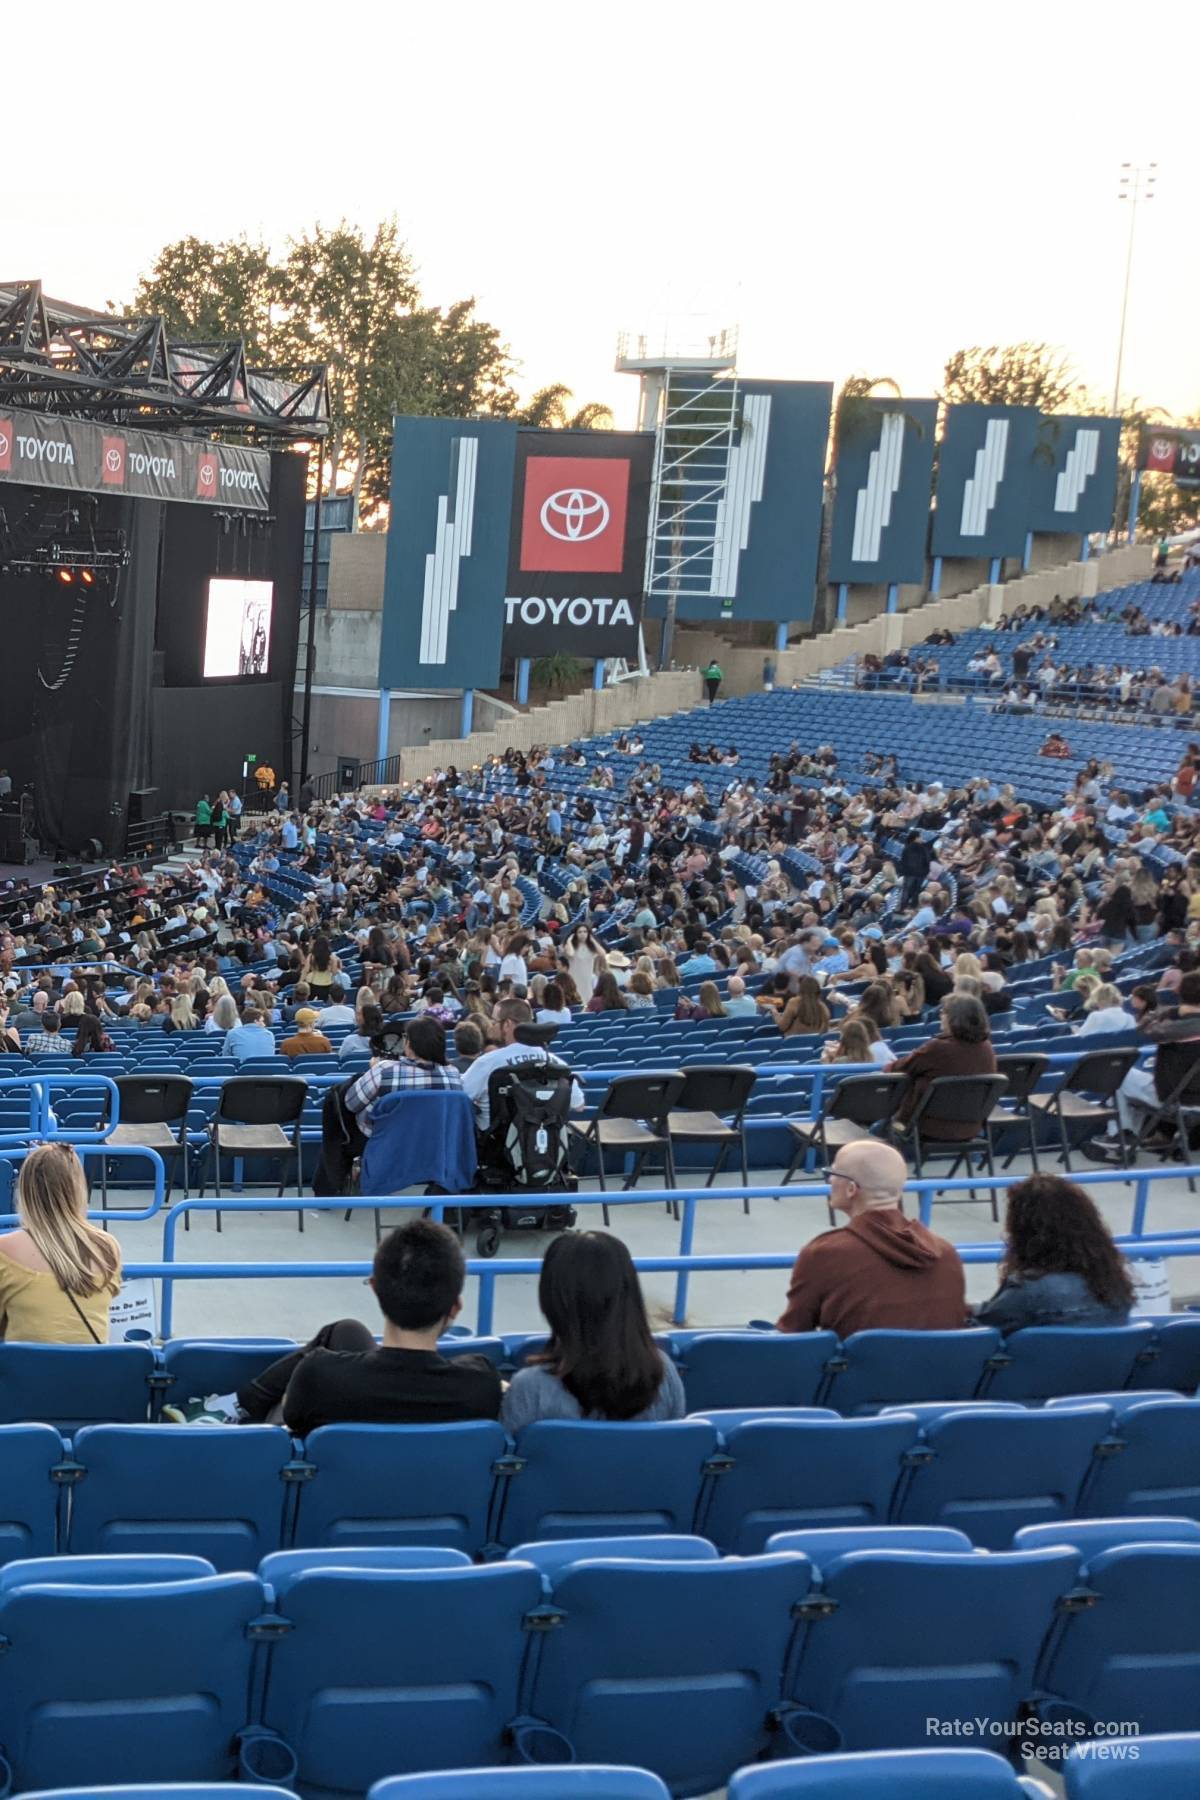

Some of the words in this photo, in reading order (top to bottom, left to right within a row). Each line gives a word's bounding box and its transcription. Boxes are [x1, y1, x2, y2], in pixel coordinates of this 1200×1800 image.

[16, 436, 75, 465] TOYOTA
[128, 453, 176, 479] TOYOTA
[219, 468, 261, 491] TOYOTA
[504, 597, 634, 625] TOYOTA
